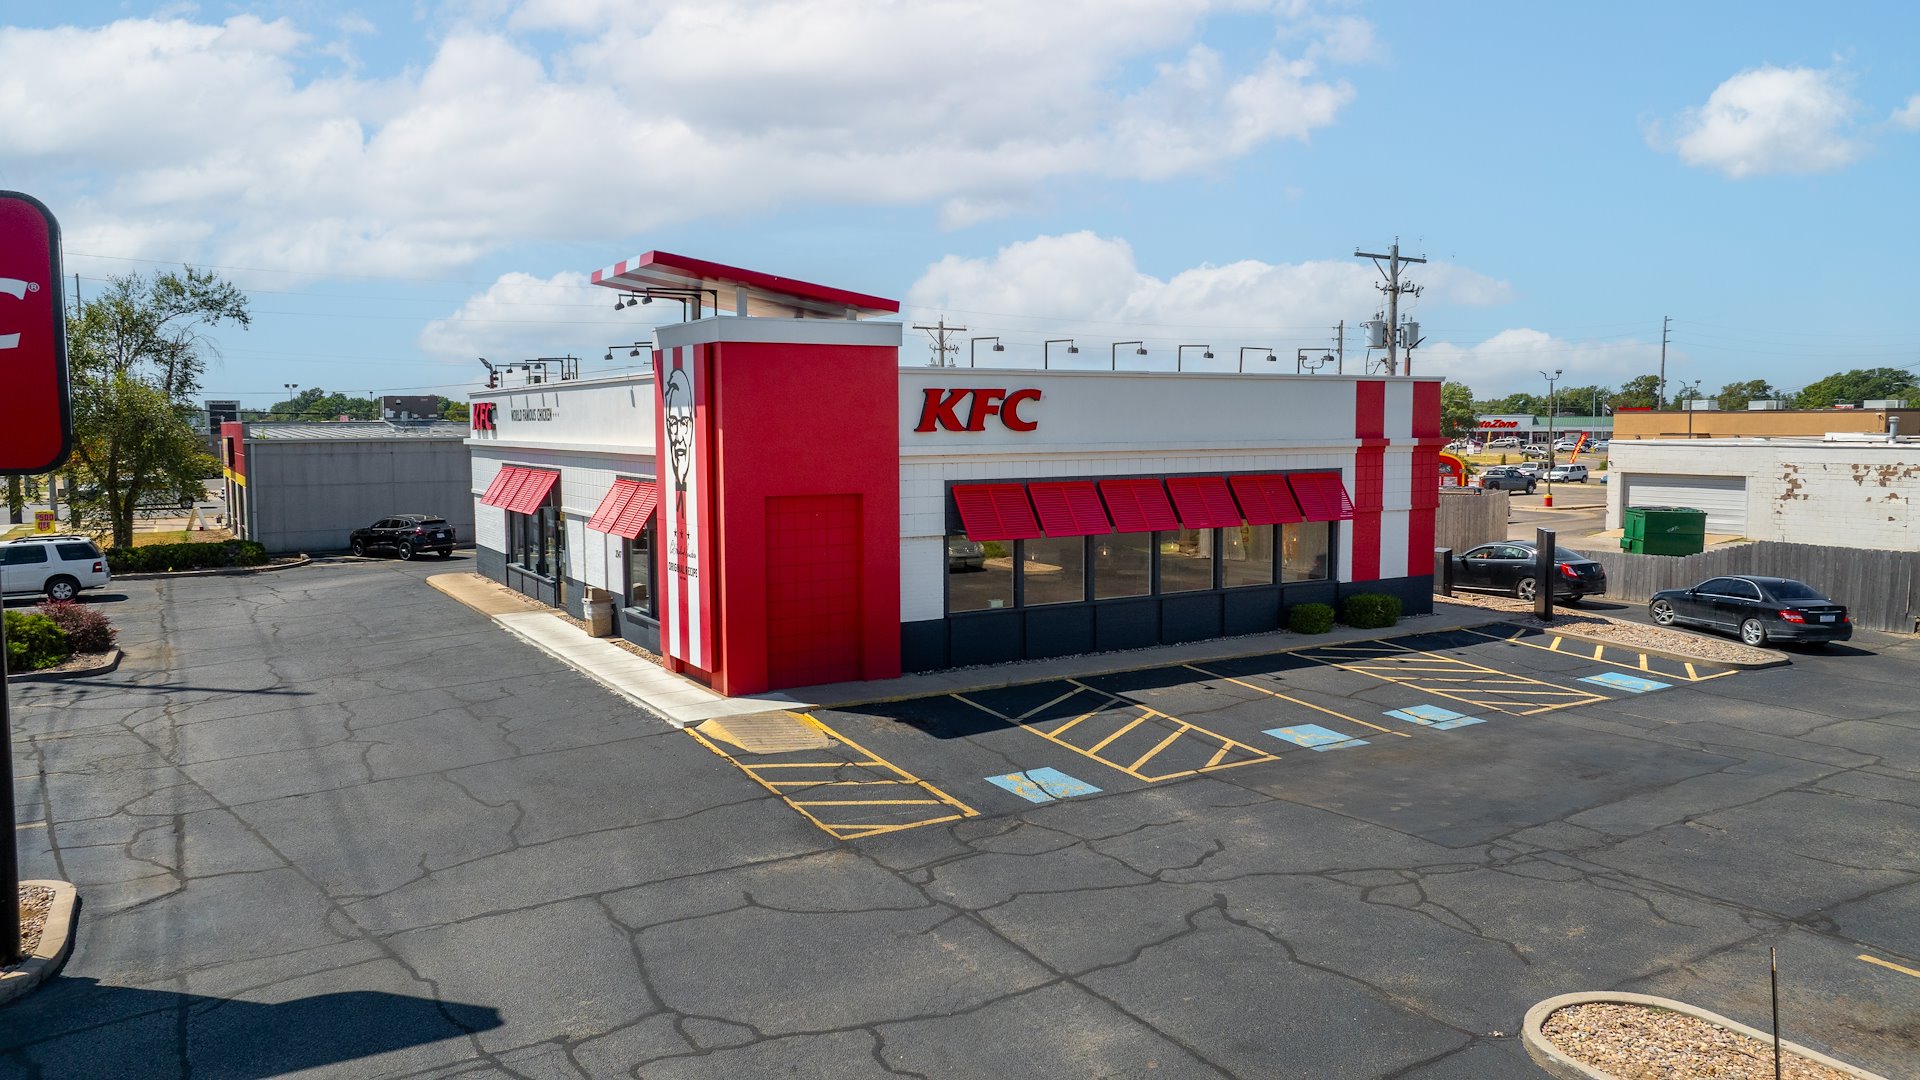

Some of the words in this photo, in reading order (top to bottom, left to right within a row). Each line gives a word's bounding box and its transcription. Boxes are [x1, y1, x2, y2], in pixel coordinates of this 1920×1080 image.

[472, 402, 496, 430] KFC
[511, 409, 522, 421] WORLD
[523, 408, 536, 421] FAMOUS
[537, 408, 552, 421] CHICKEN
[914, 388, 1042, 432] KFC
[1476, 419, 1518, 428] toZone
[669, 561, 685, 574] ORIGINAL
[686, 566, 697, 578] RECIPE
